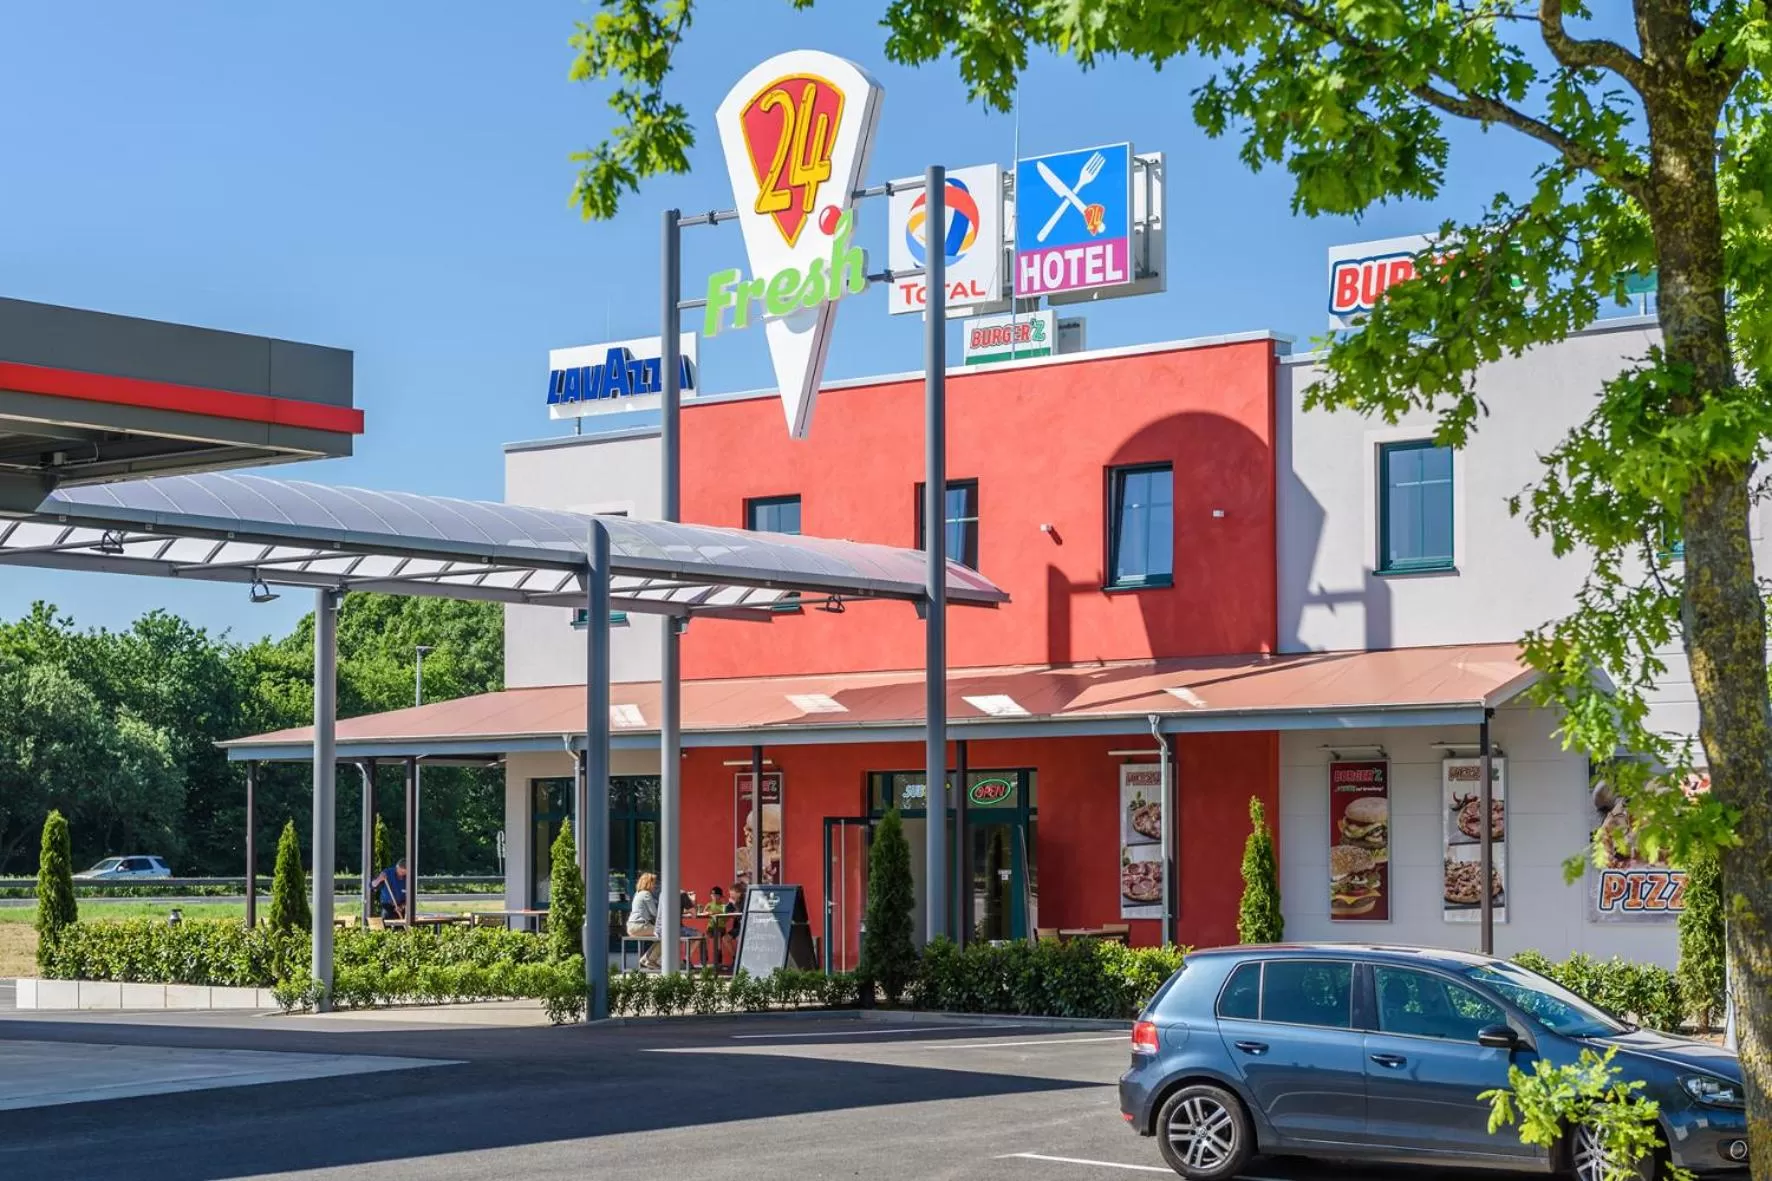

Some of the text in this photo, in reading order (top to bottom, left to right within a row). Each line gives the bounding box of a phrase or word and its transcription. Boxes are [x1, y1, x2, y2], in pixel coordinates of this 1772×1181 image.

[755, 82, 832, 215] 24
[703, 208, 867, 338] Fresh
[1020, 243, 1123, 293] HOTEL
[899, 279, 986, 305] TOAL
[970, 318, 1046, 350] BURGER'Z
[975, 784, 1005, 799] OPEN
[1600, 870, 1689, 912] PIZZ
